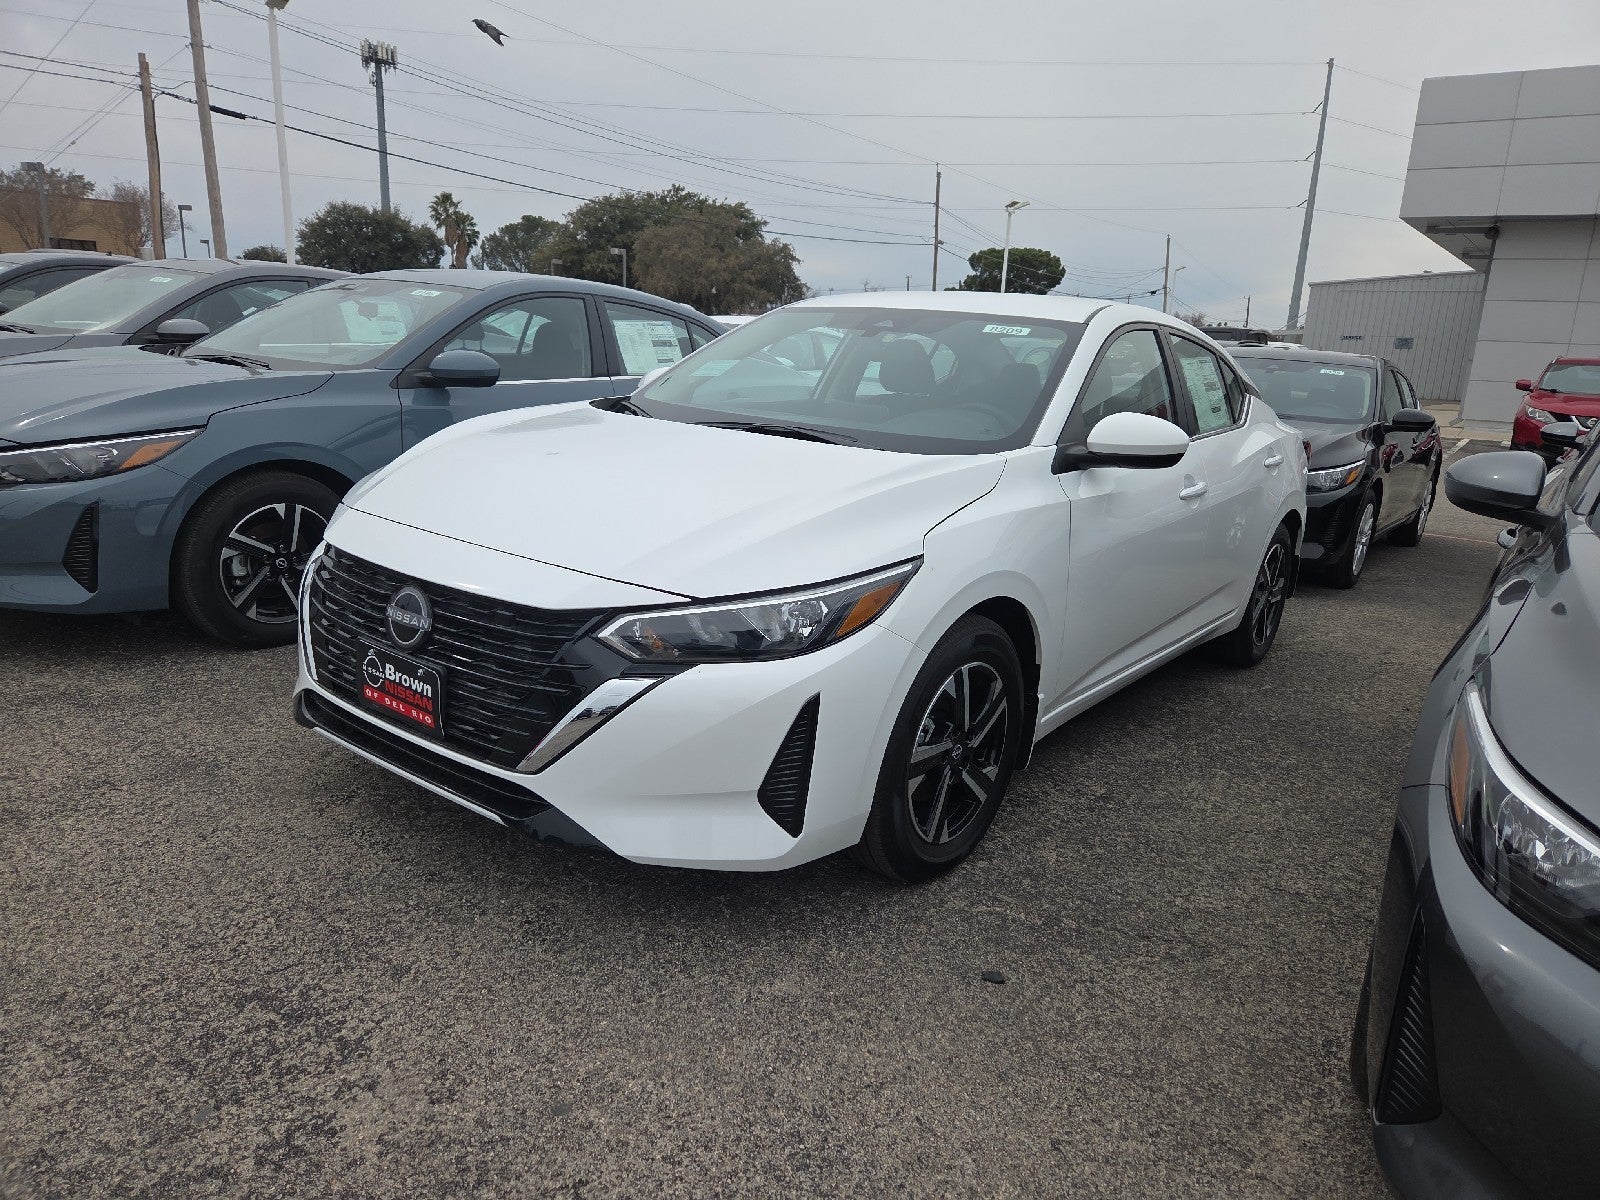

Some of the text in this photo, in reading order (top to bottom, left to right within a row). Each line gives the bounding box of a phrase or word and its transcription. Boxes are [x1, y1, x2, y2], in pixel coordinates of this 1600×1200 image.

[387, 605, 429, 629] NISSAN
[385, 662, 432, 698] Brown
[384, 697, 405, 712] DEL
[411, 709, 432, 724] RIO
[385, 680, 433, 712] NISSAN
